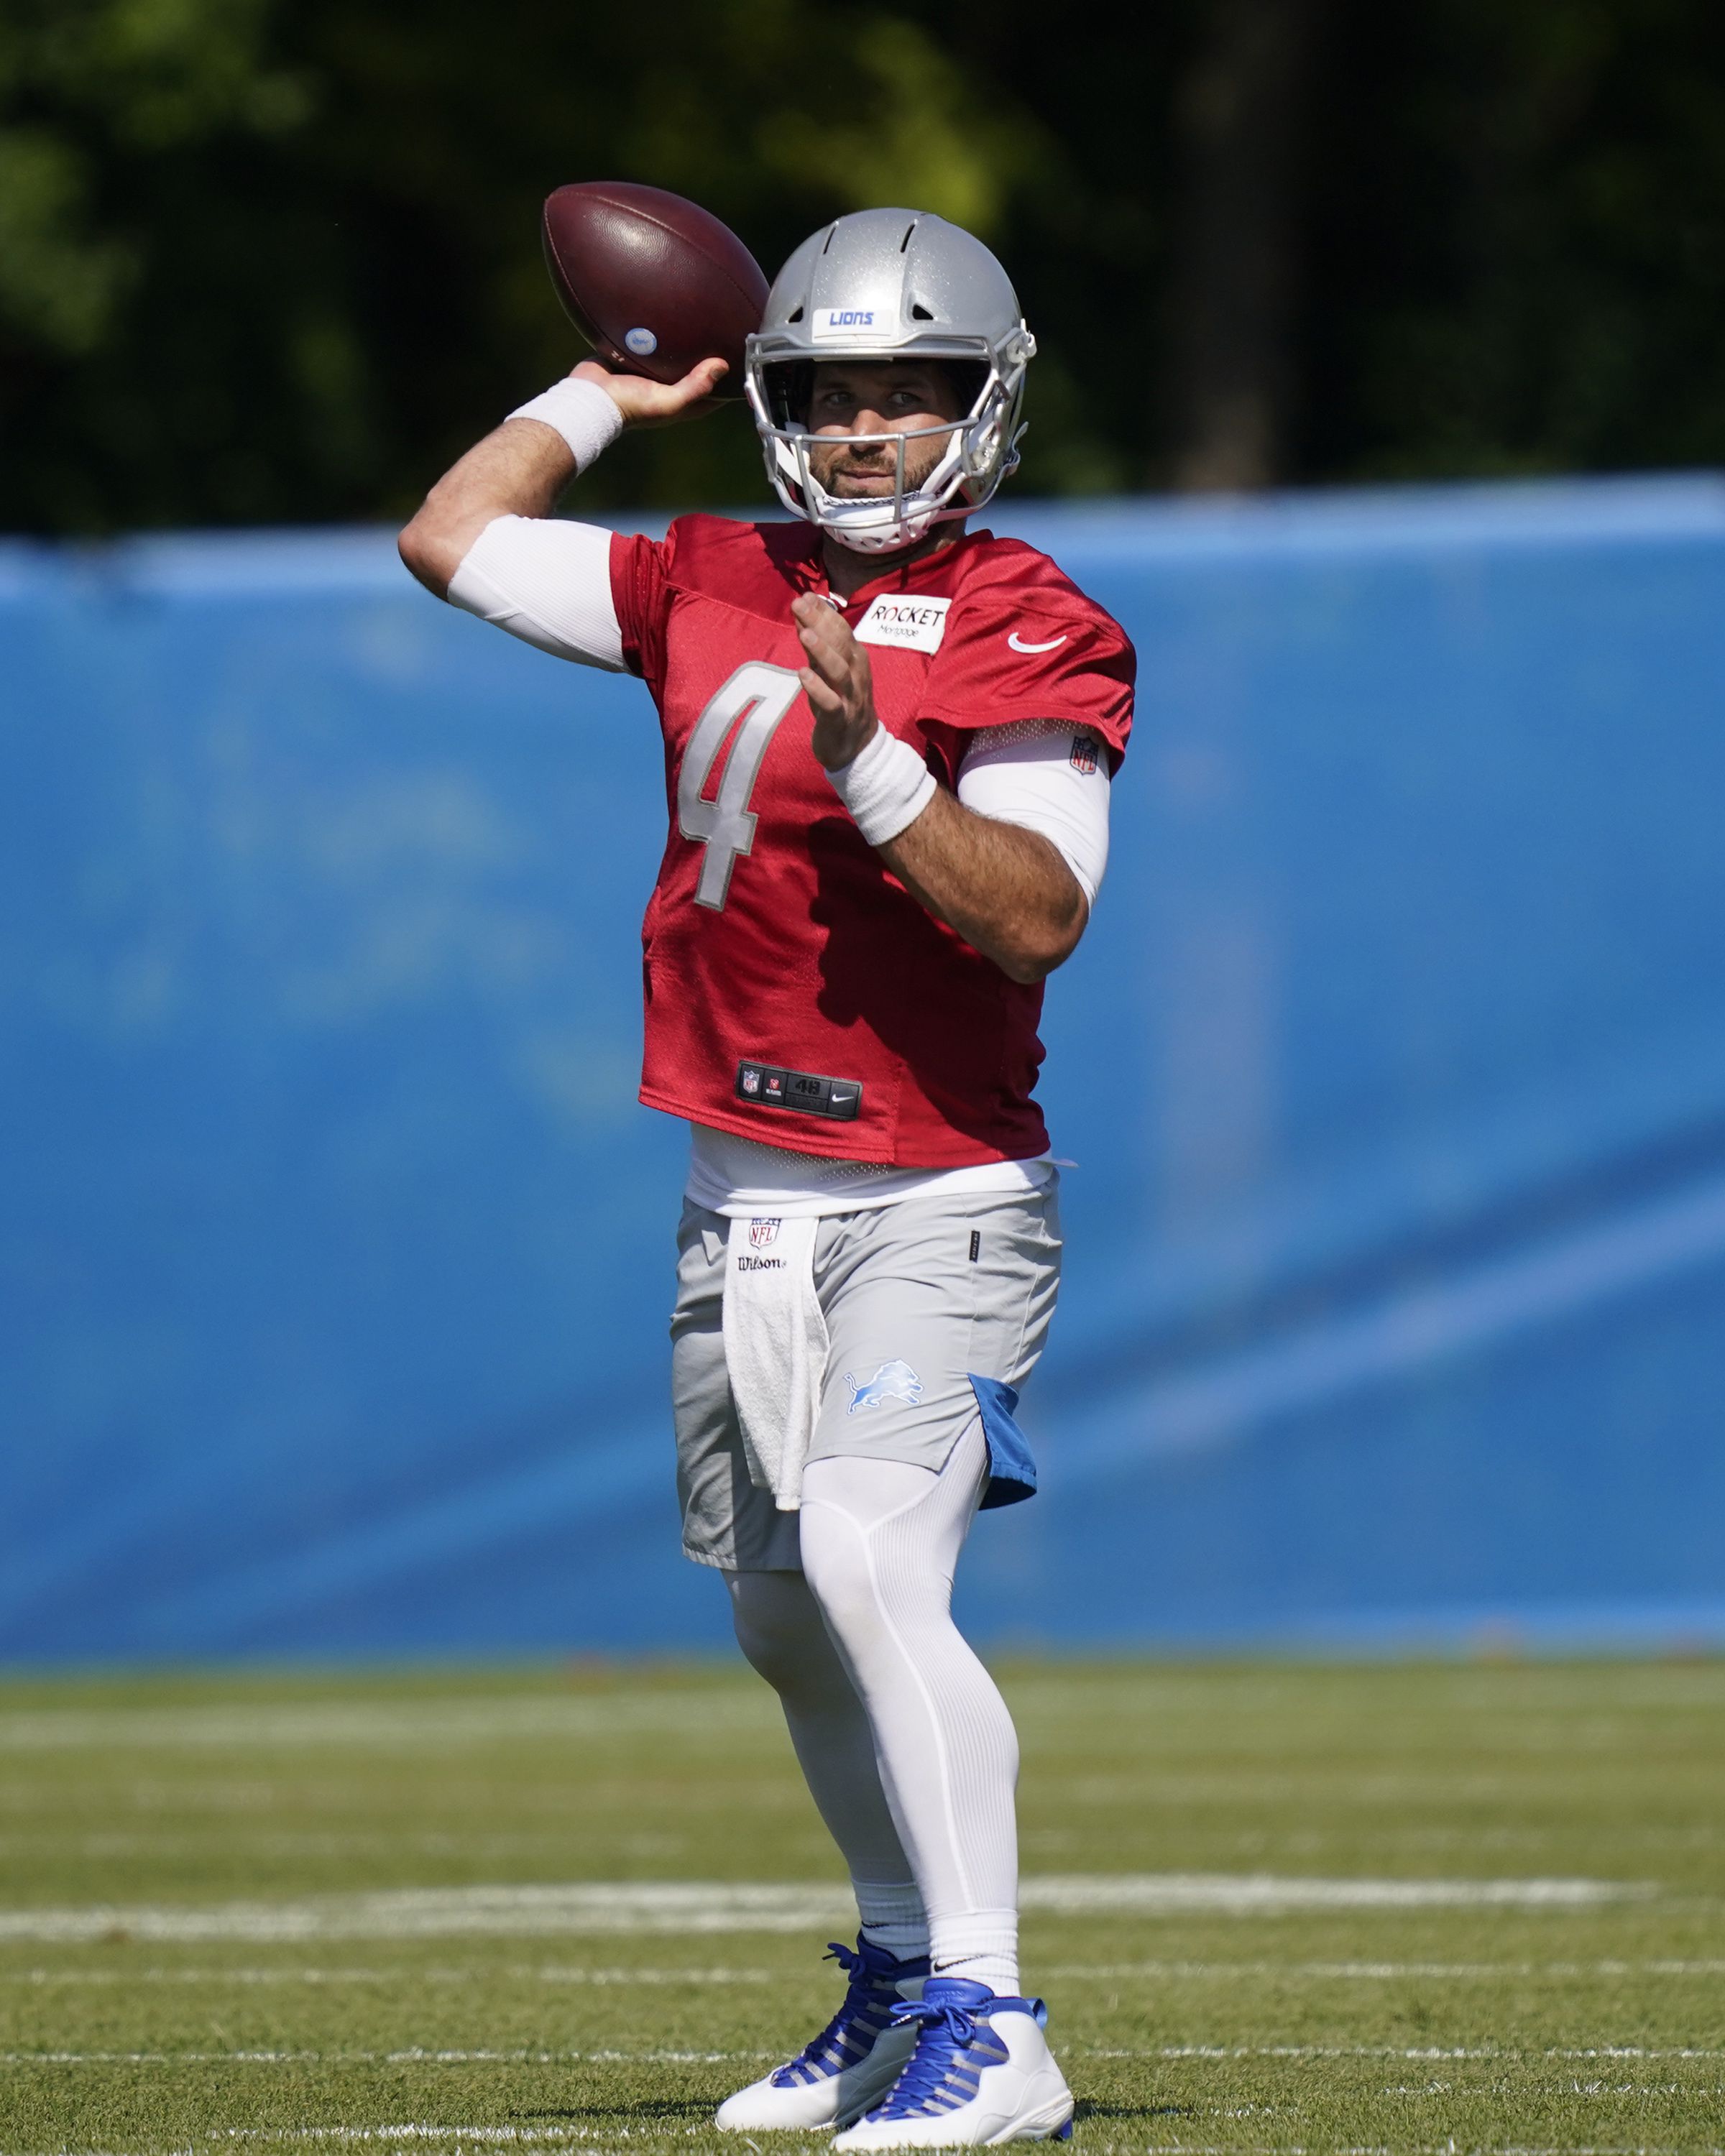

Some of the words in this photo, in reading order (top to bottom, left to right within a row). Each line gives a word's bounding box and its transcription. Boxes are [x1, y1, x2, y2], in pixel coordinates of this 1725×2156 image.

[829, 311, 874, 326] LIONS
[871, 605, 944, 627] ROCKET
[878, 624, 919, 638] Mortgage
[1072, 748, 1096, 771] NFL
[677, 660, 803, 912] 4
[795, 1079, 820, 1095] 48
[750, 1226, 772, 1245] NFL
[738, 1256, 781, 1271] Wilson
